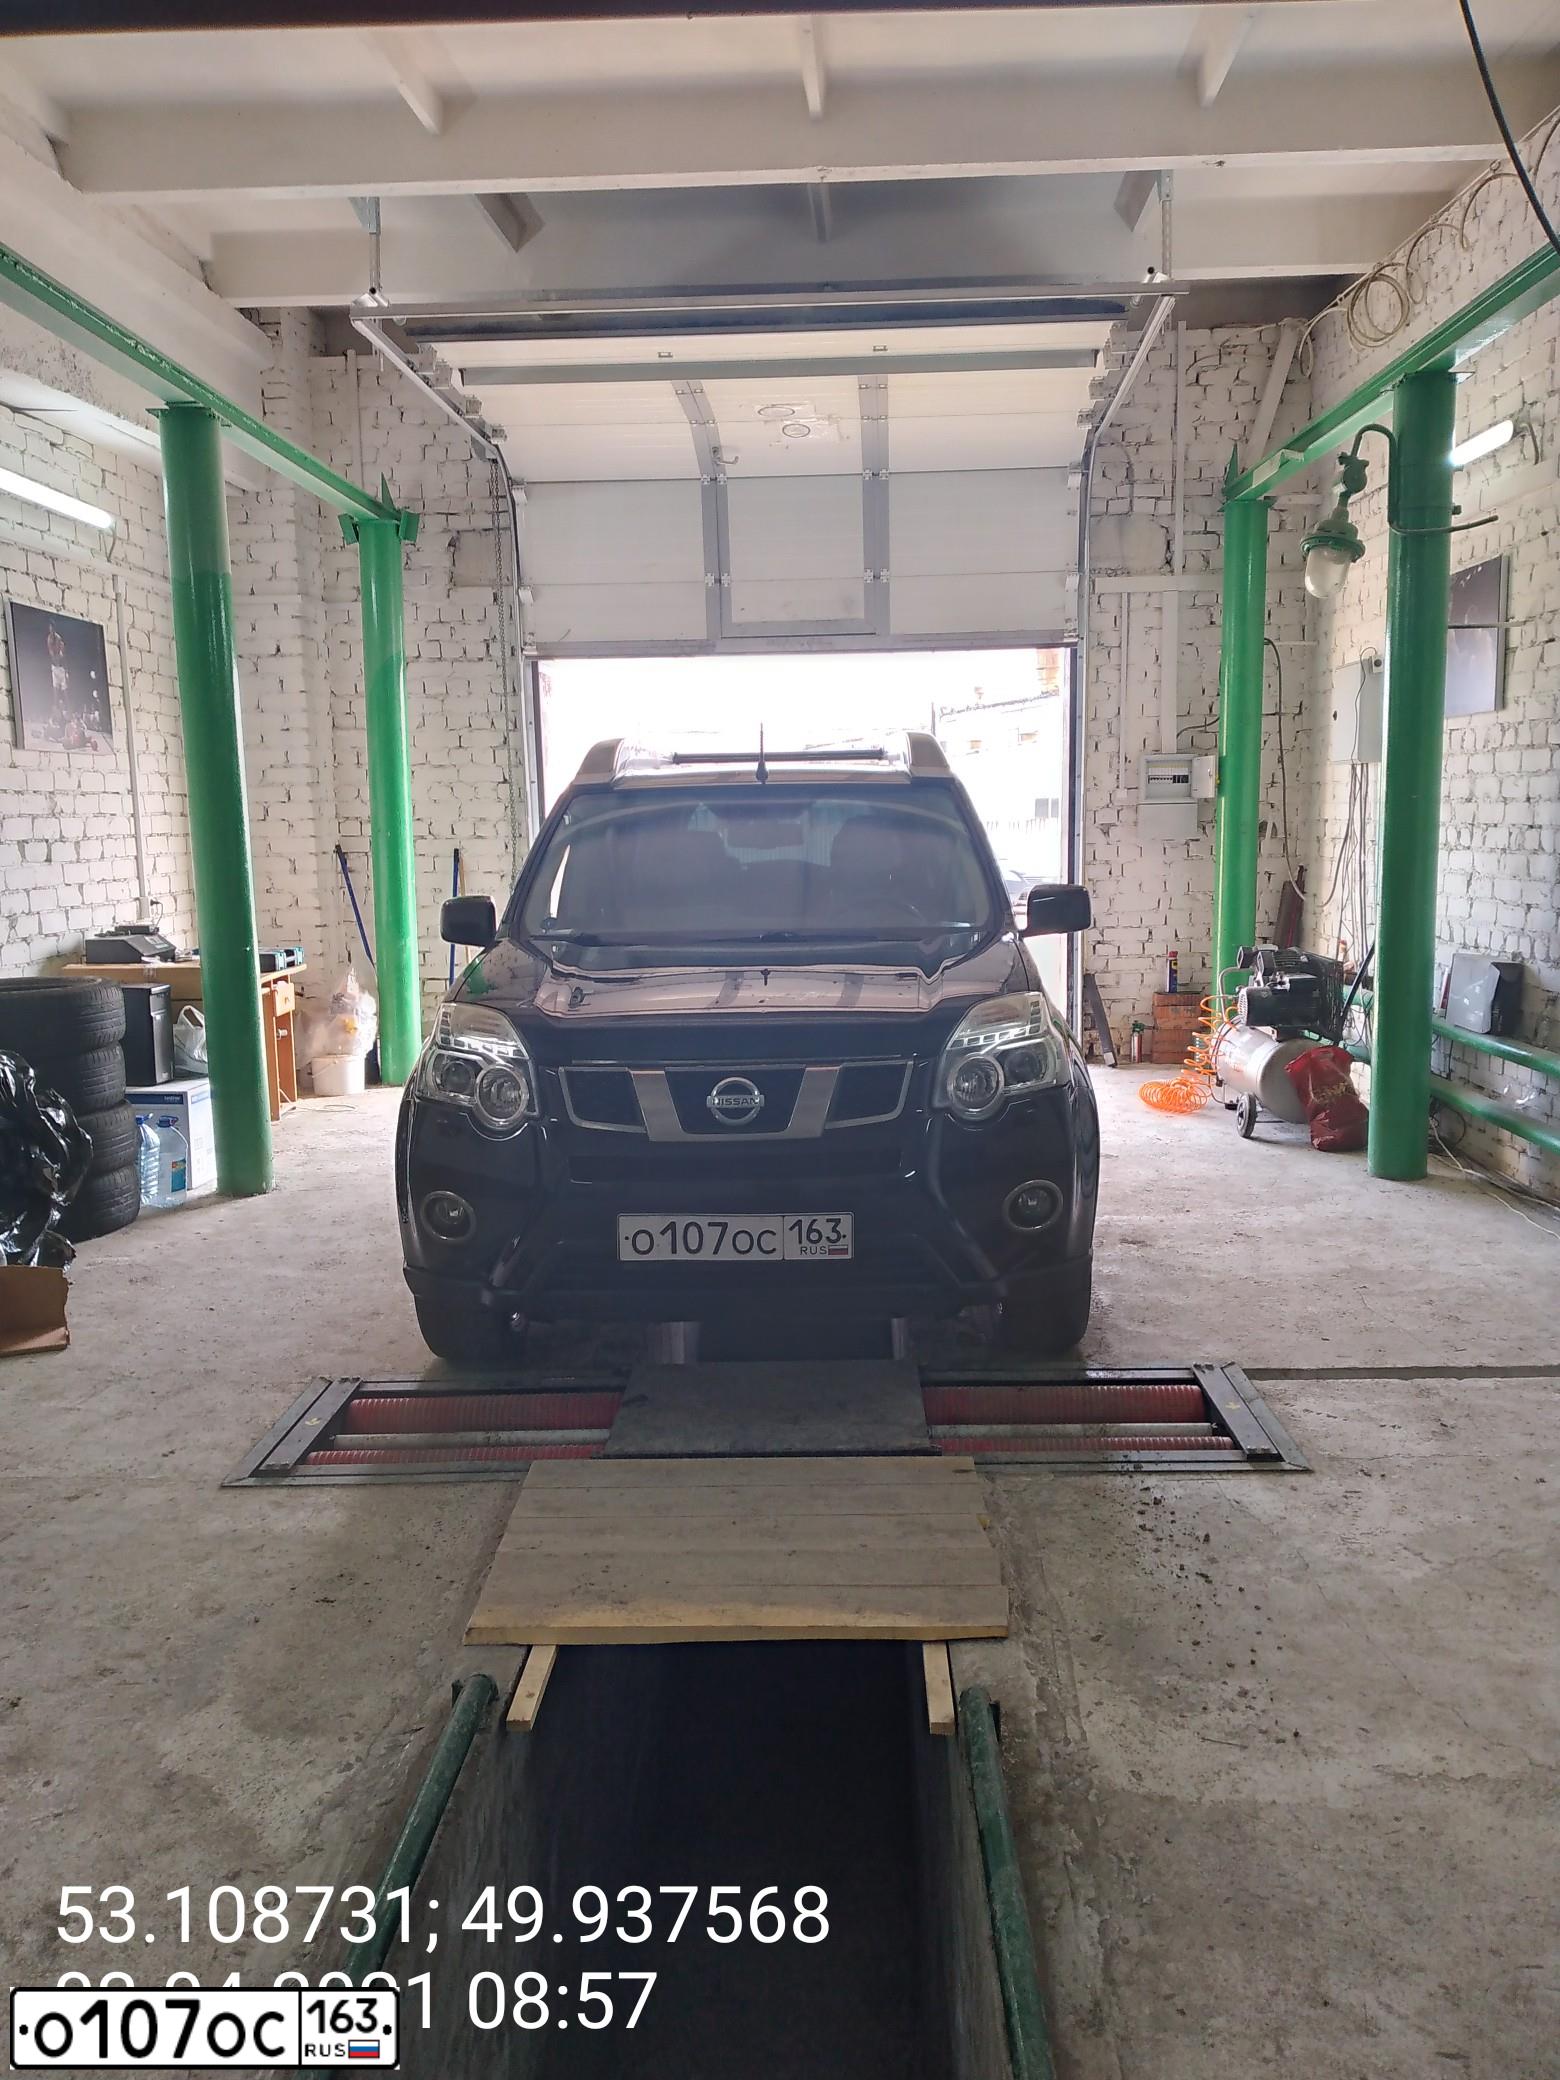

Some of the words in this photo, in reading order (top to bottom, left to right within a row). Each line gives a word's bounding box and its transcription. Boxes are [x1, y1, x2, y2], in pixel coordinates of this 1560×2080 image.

[712, 1097, 760, 1106] NISSAN
[788, 1218, 842, 1245] 163
[800, 1246, 827, 1256] RUS
